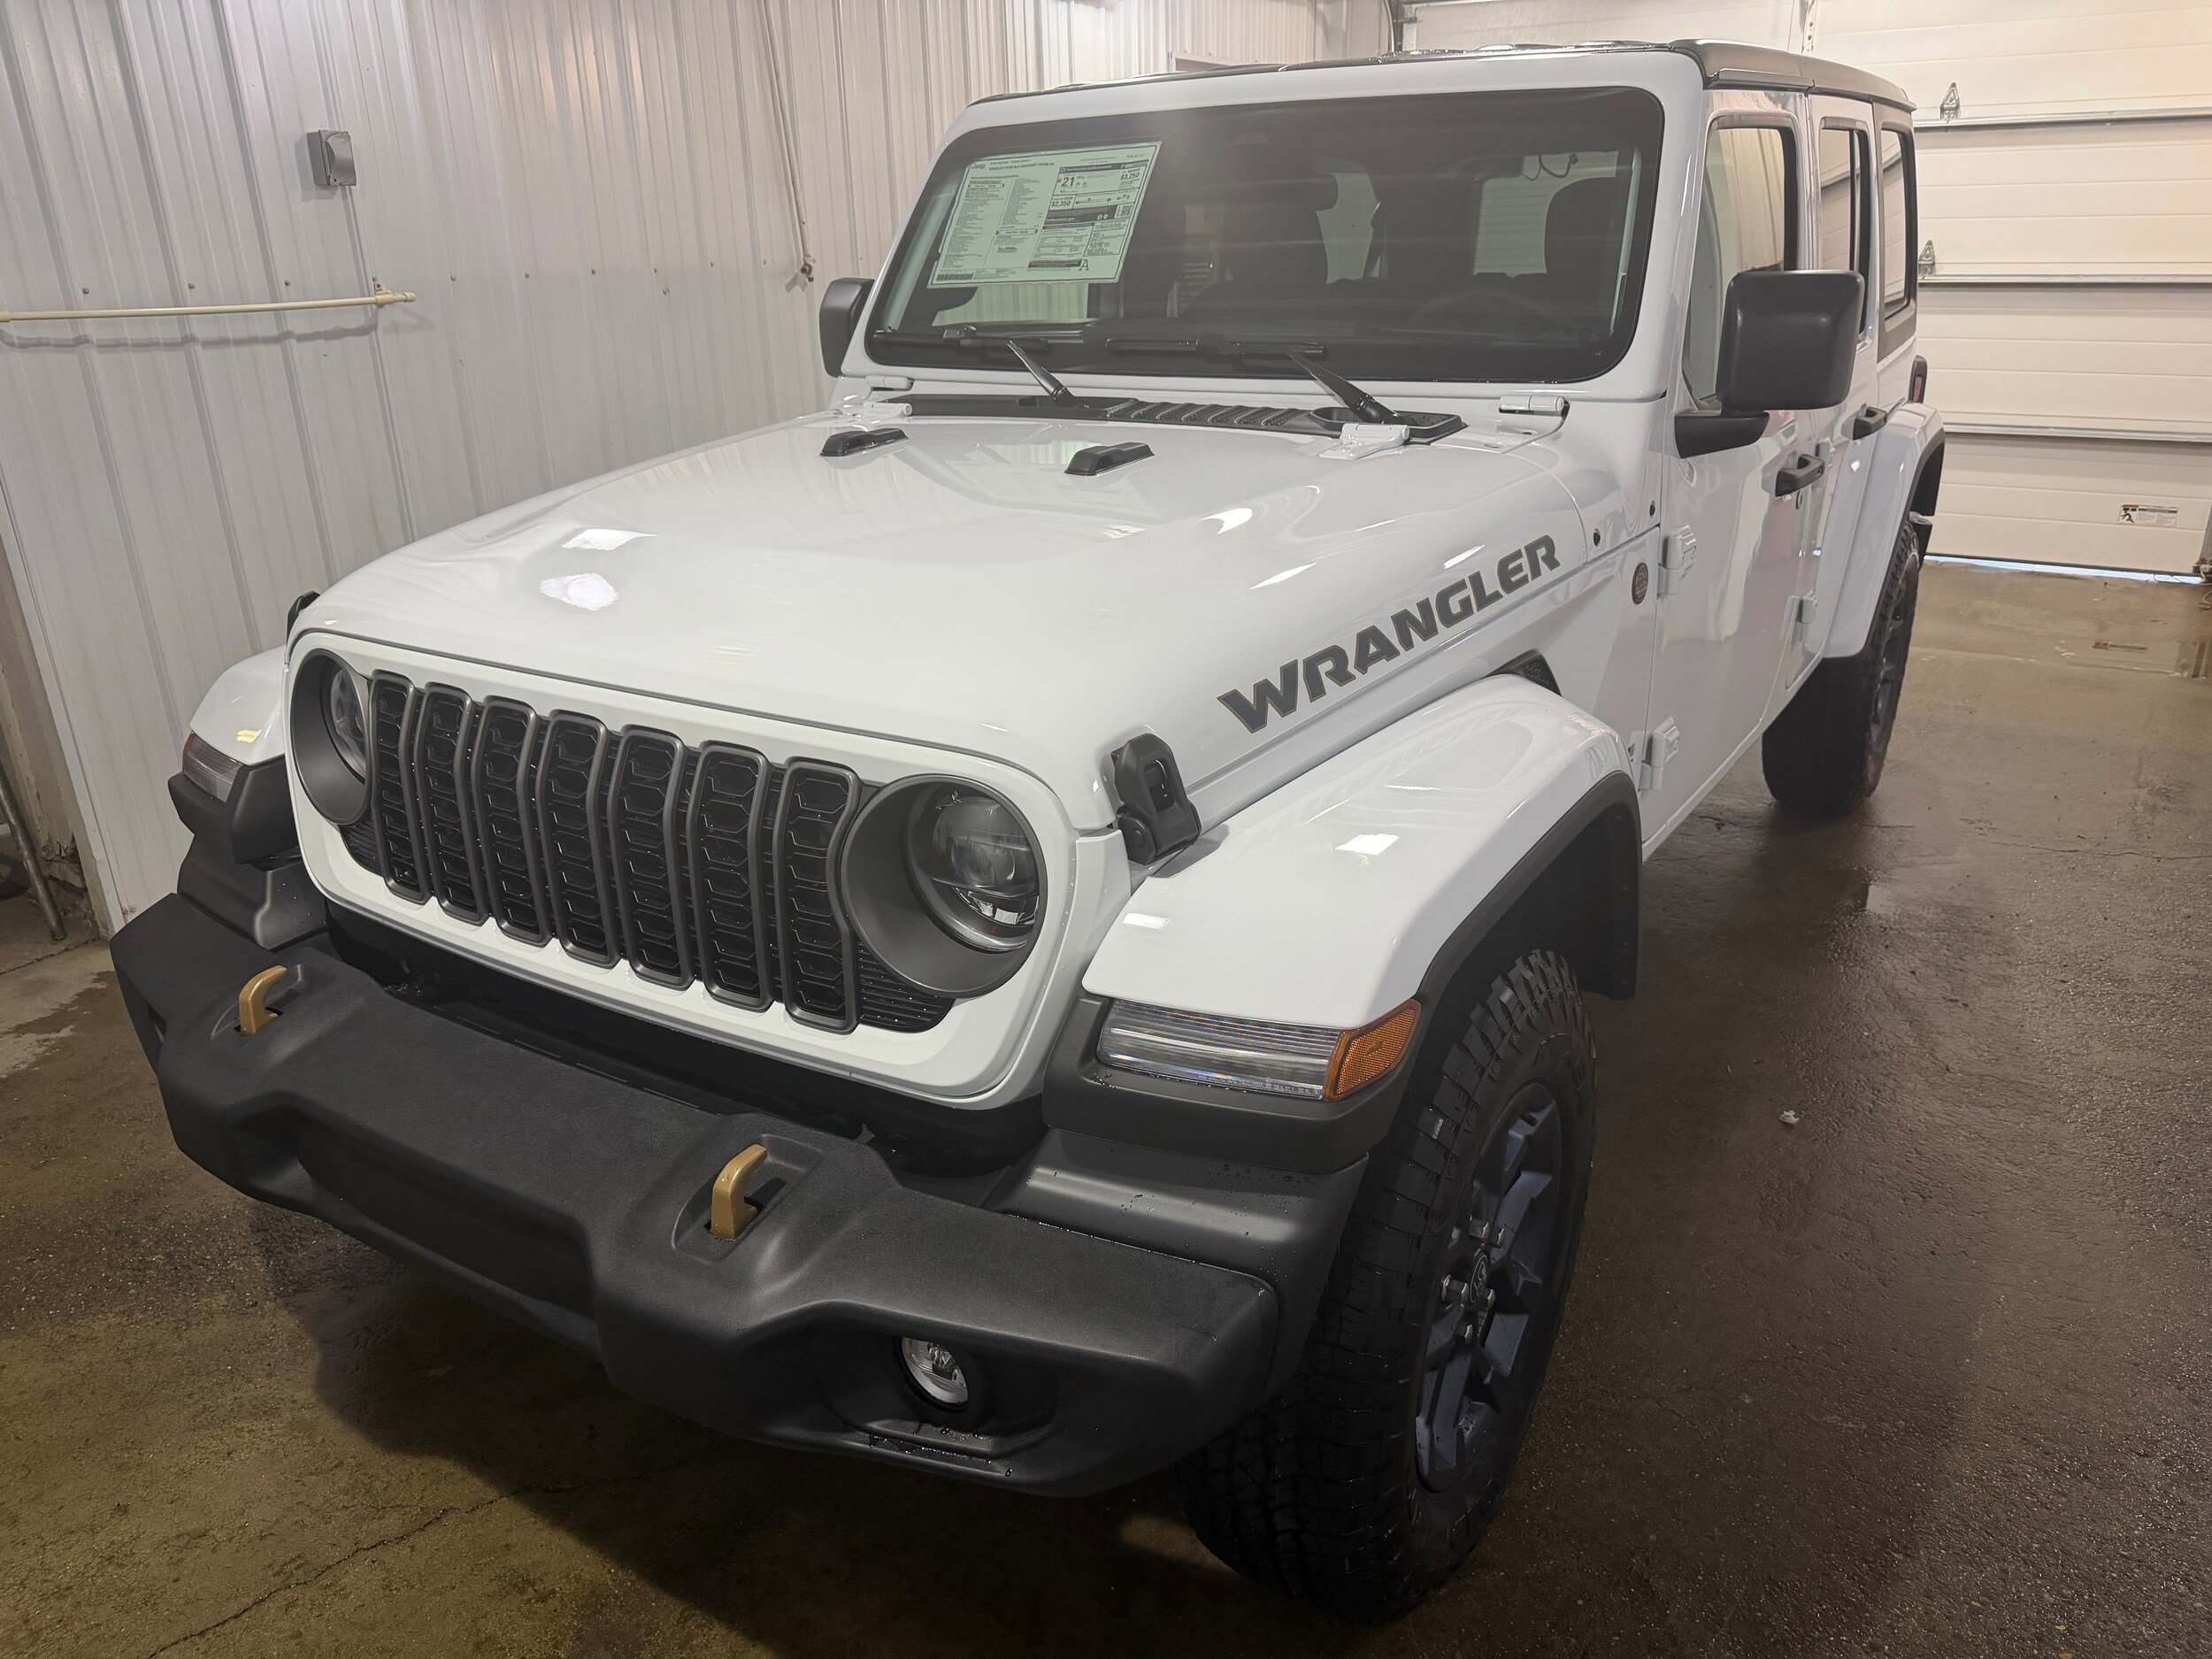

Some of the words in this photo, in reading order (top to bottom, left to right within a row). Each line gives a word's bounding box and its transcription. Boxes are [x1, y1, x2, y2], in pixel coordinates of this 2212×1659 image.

[1061, 176, 1075, 187] 21
[1079, 258, 1089, 271] A
[1217, 534, 1561, 733] WRANGLER
